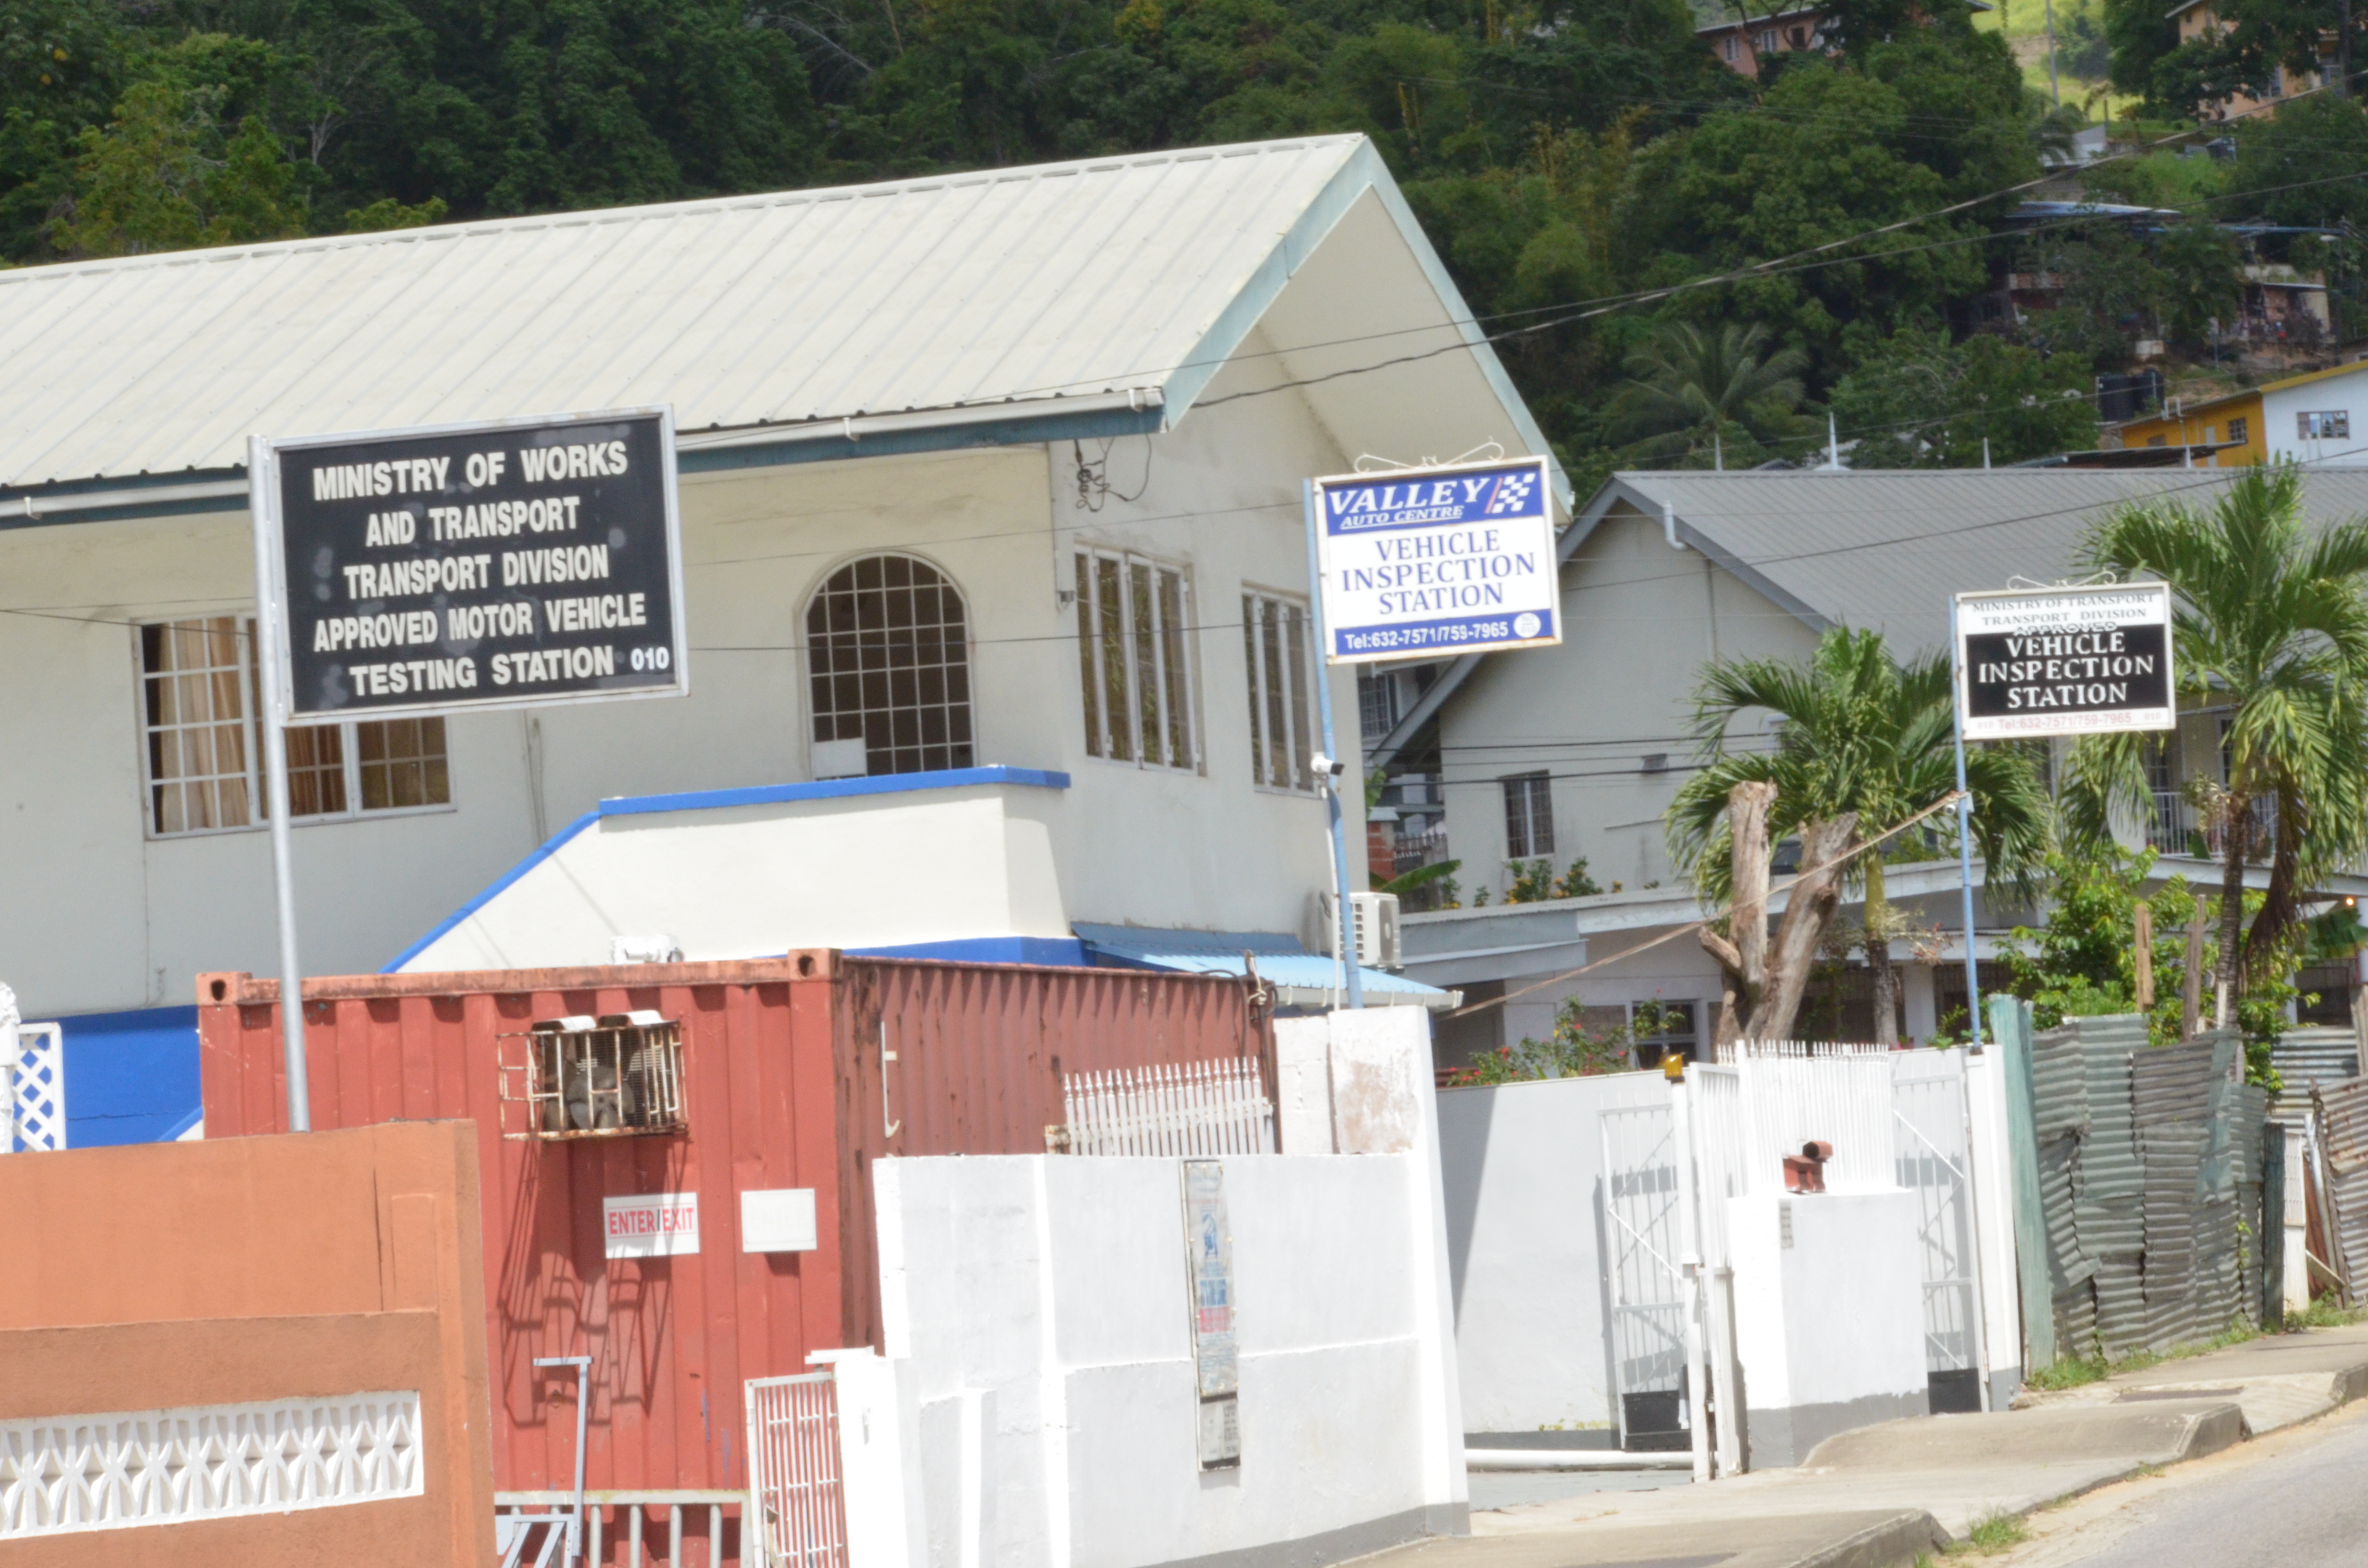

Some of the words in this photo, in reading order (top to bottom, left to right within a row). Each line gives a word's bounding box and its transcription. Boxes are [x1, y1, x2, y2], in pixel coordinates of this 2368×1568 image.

[313, 457, 450, 501] MINISTRY
[466, 453, 505, 487] OF
[521, 441, 628, 482] WORKS
[1329, 478, 1490, 514] VALLEY
[365, 511, 415, 547] AND
[429, 497, 580, 541] TRANSPORT
[1342, 513, 1389, 527] AUTO
[1394, 506, 1464, 521] CENTRE
[1375, 529, 1500, 561] VEHICLE
[344, 555, 491, 600] TRANSPORT
[503, 544, 609, 586] DIVISION
[1342, 552, 1535, 592] INSPECTION
[1380, 582, 1503, 614] STATION
[1973, 599, 2041, 612] MINISTRY
[2046, 599, 2064, 608] OF
[2069, 594, 2156, 607] TRANSPORT
[314, 611, 438, 652] APPROVED
[448, 602, 532, 642] MOTOR
[545, 593, 646, 633] VEHICLE
[1982, 612, 2070, 626] TRANSPORT
[2081, 608, 2147, 621] DIVISION
[2013, 621, 2118, 637] APPROVED
[2006, 632, 2125, 658] VEHICLE
[349, 658, 477, 696] TESTING
[492, 646, 614, 685] STATION
[631, 647, 669, 671] 010
[1979, 655, 2154, 684] INSPECTION
[2008, 683, 2128, 709] STATION
